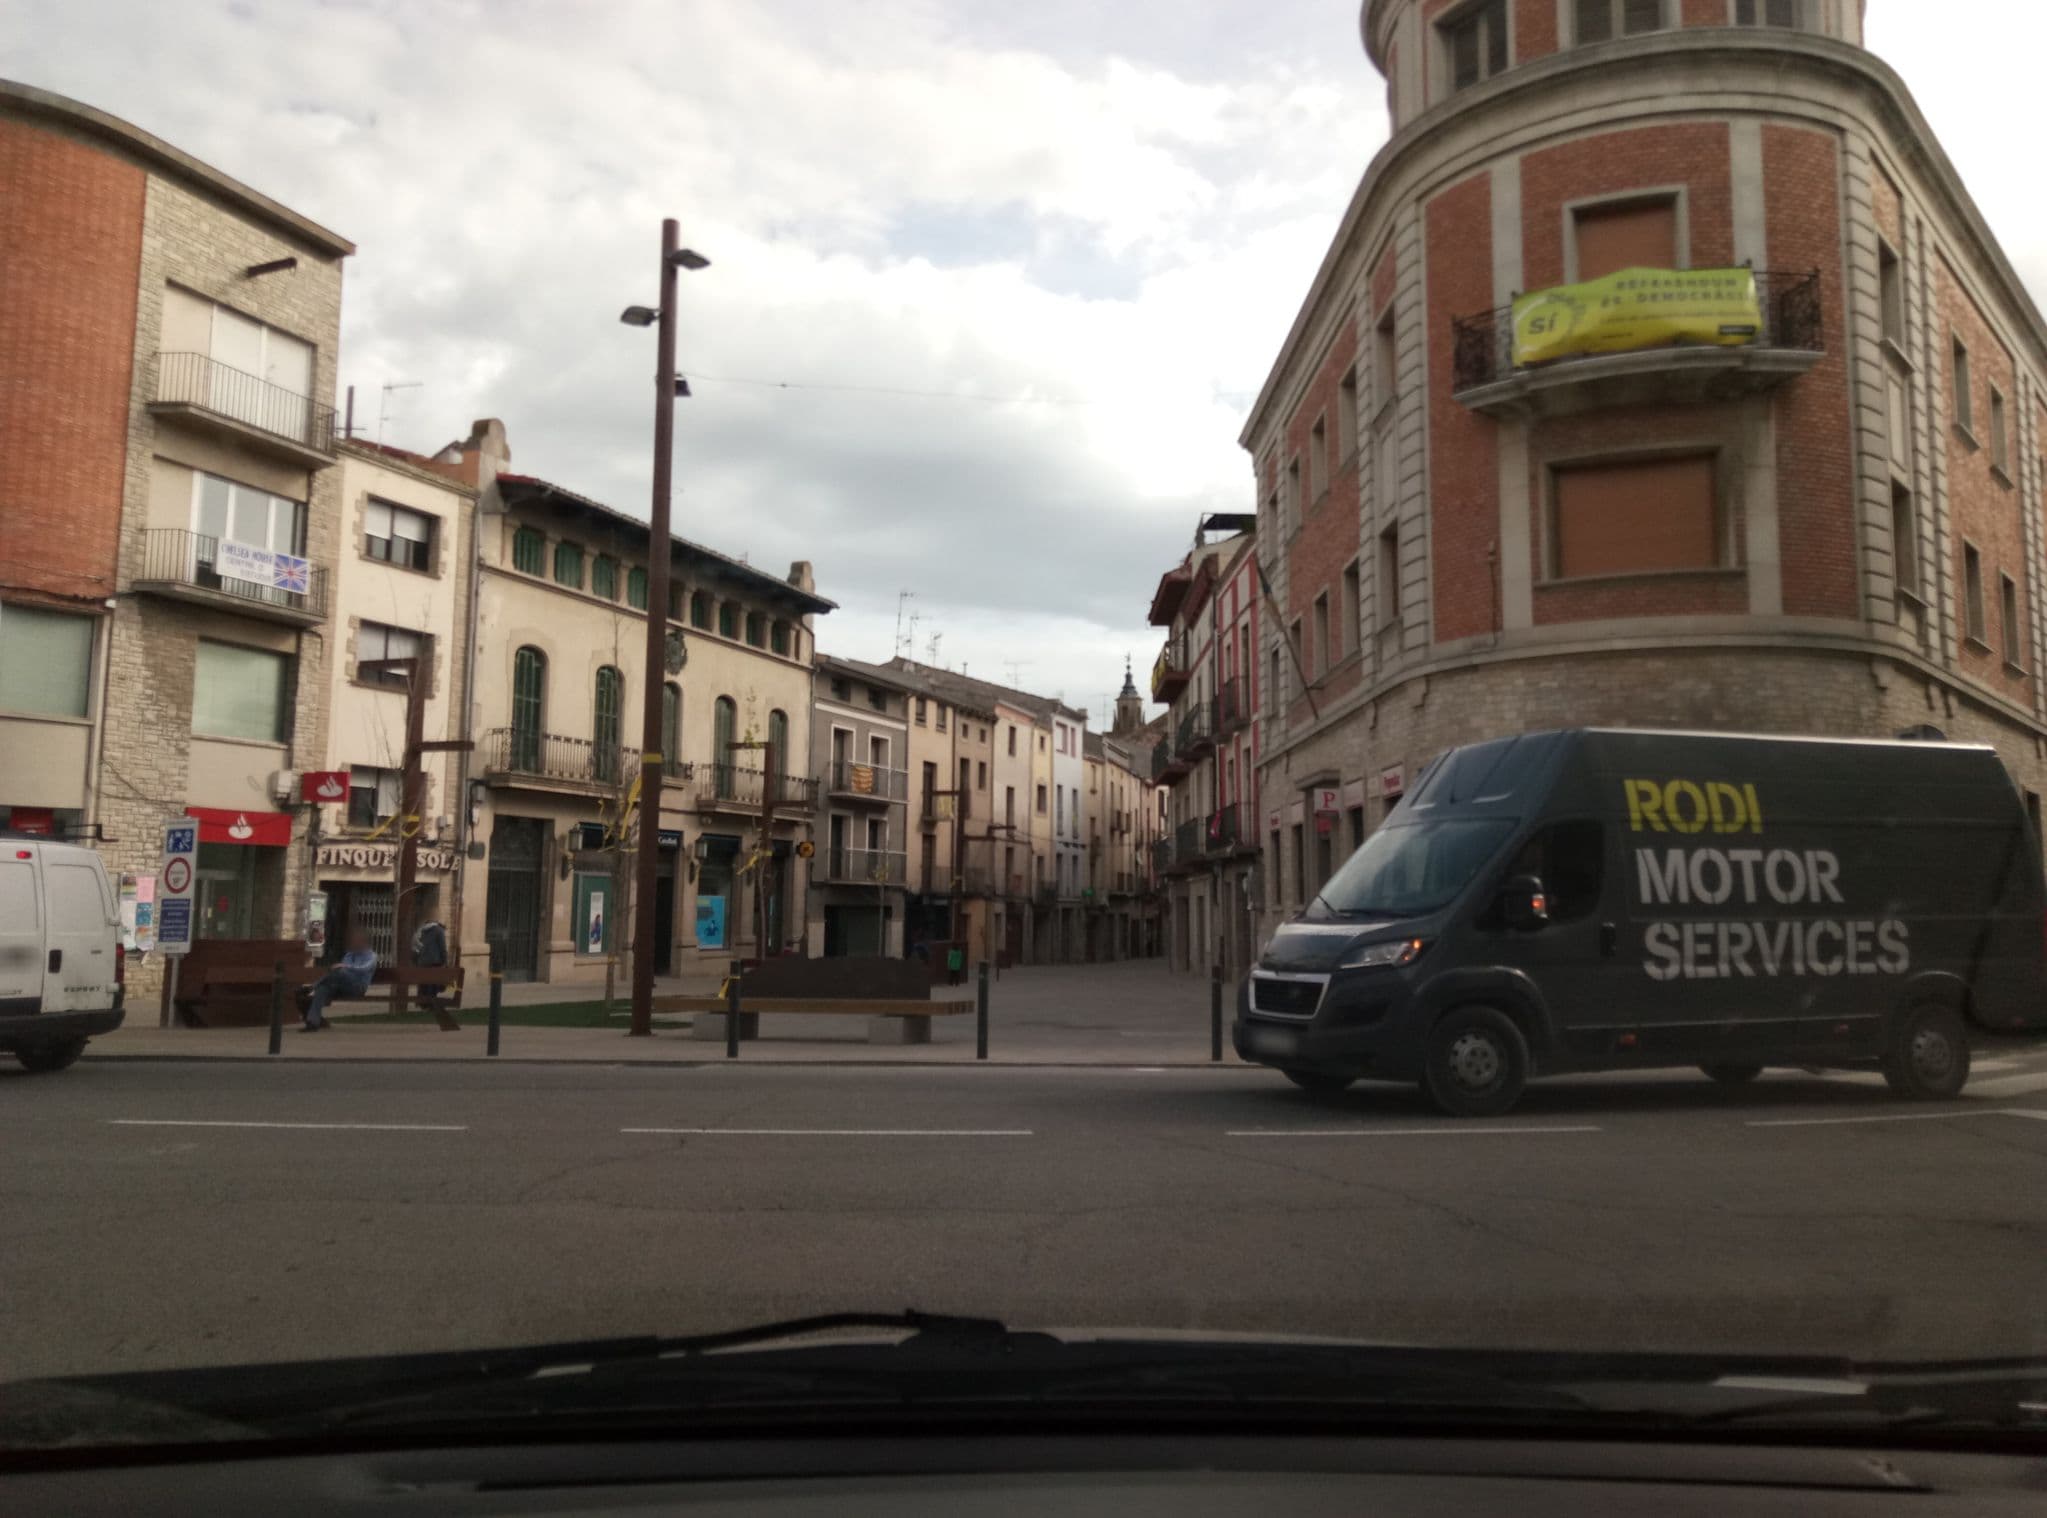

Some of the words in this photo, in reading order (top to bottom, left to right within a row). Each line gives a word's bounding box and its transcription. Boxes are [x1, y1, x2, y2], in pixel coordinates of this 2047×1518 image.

[1322, 791, 1336, 808] P
[1624, 779, 1763, 834] RODI
[1635, 848, 1845, 904] MOTOR
[1643, 920, 1910, 980] SERVICES
